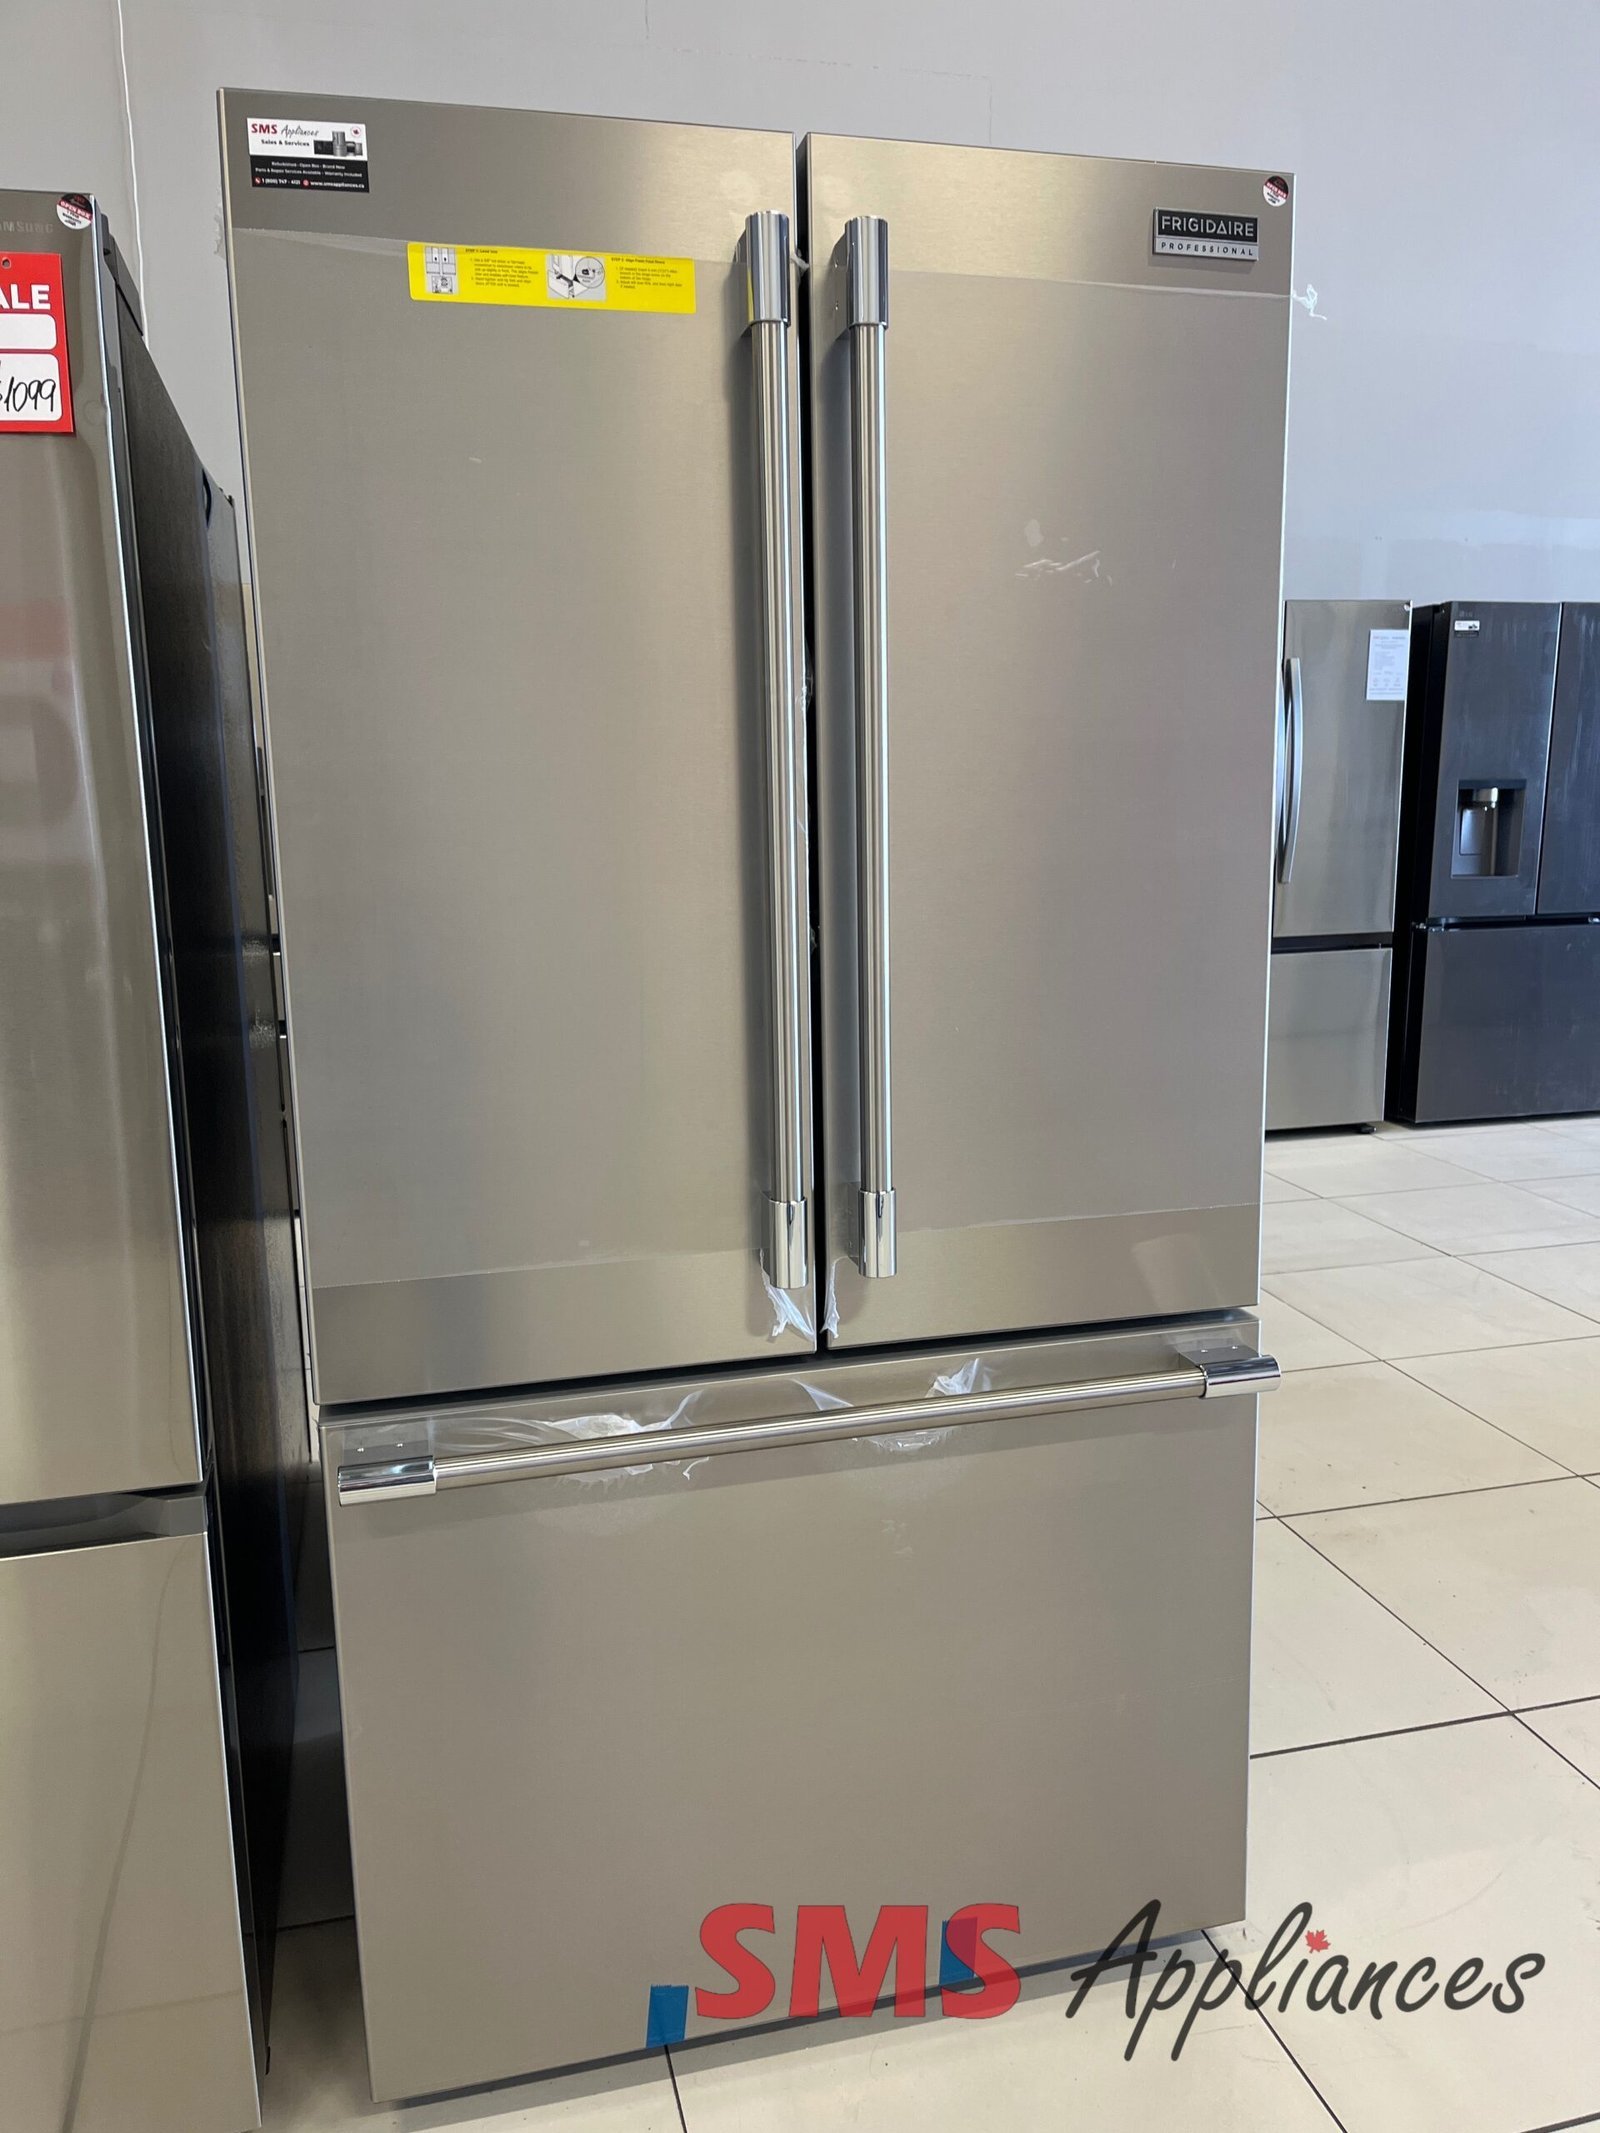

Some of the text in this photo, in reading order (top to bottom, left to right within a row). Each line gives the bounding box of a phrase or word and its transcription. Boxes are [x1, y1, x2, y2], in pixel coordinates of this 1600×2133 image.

[252, 123, 319, 138] SMS Appliances
[0, 220, 54, 233] MSUNG
[1161, 216, 1254, 237] FRIGIDAIRE
[1161, 242, 1253, 256] PROFESSIONAL
[0, 376, 57, 413] 1099
